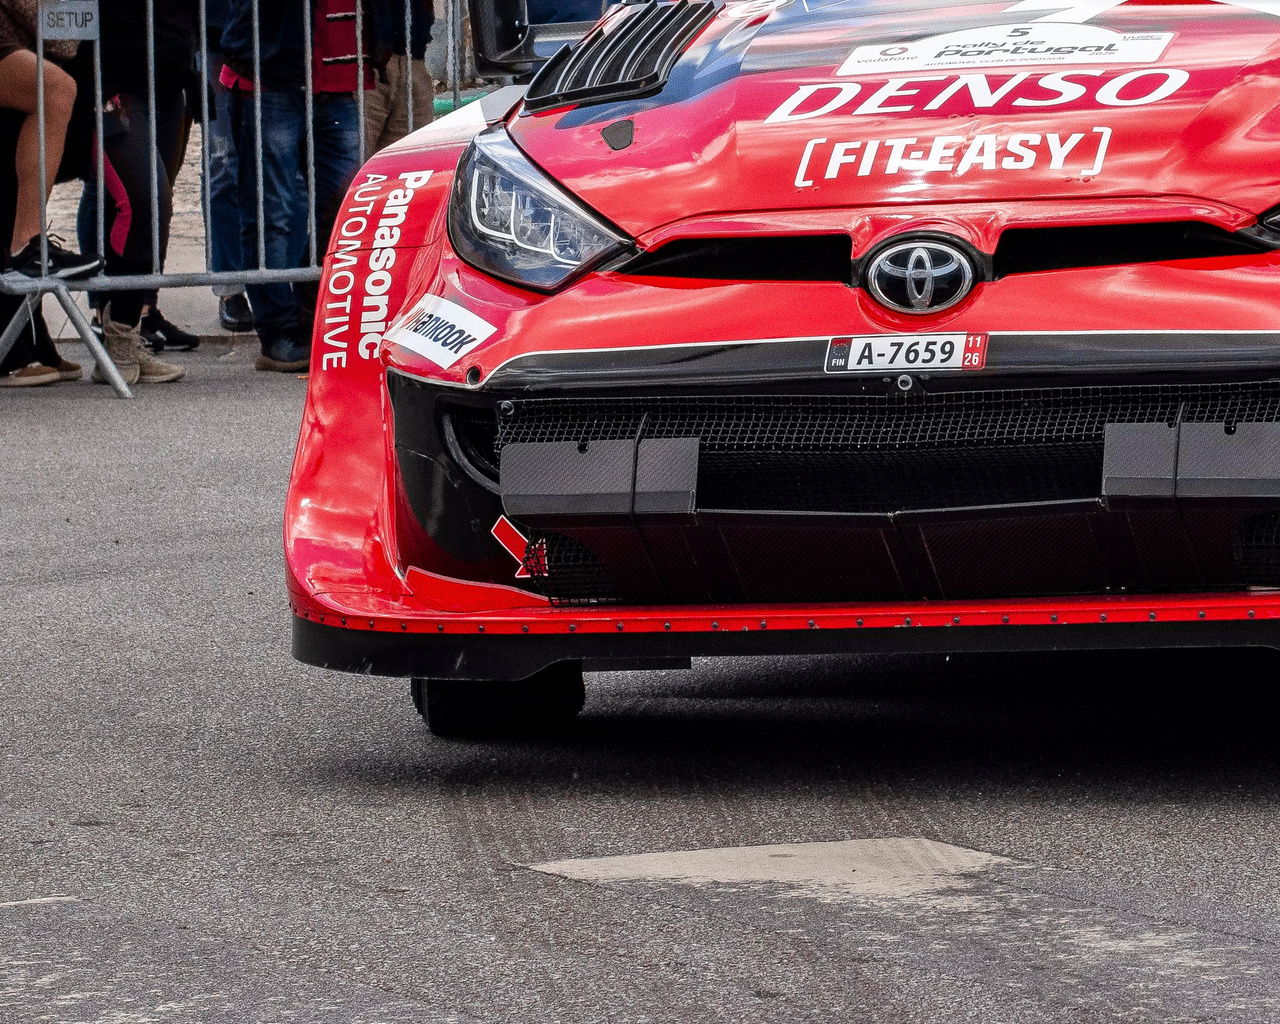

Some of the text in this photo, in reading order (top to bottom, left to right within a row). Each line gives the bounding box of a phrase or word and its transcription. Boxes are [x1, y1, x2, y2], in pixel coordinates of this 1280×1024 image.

[46, 10, 93, 28] SETUP
[1006, 27, 1033, 38] 5
[933, 43, 1119, 59] Portugal
[943, 41, 1007, 50] rally
[857, 55, 919, 64] vodafone
[763, 68, 1191, 125] DENSO
[322, 173, 388, 371] AUTOMOTIVE
[358, 169, 434, 360] Panasonic
[968, 335, 981, 347] 11
[856, 340, 955, 366] A-7659
[964, 353, 980, 365] 26
